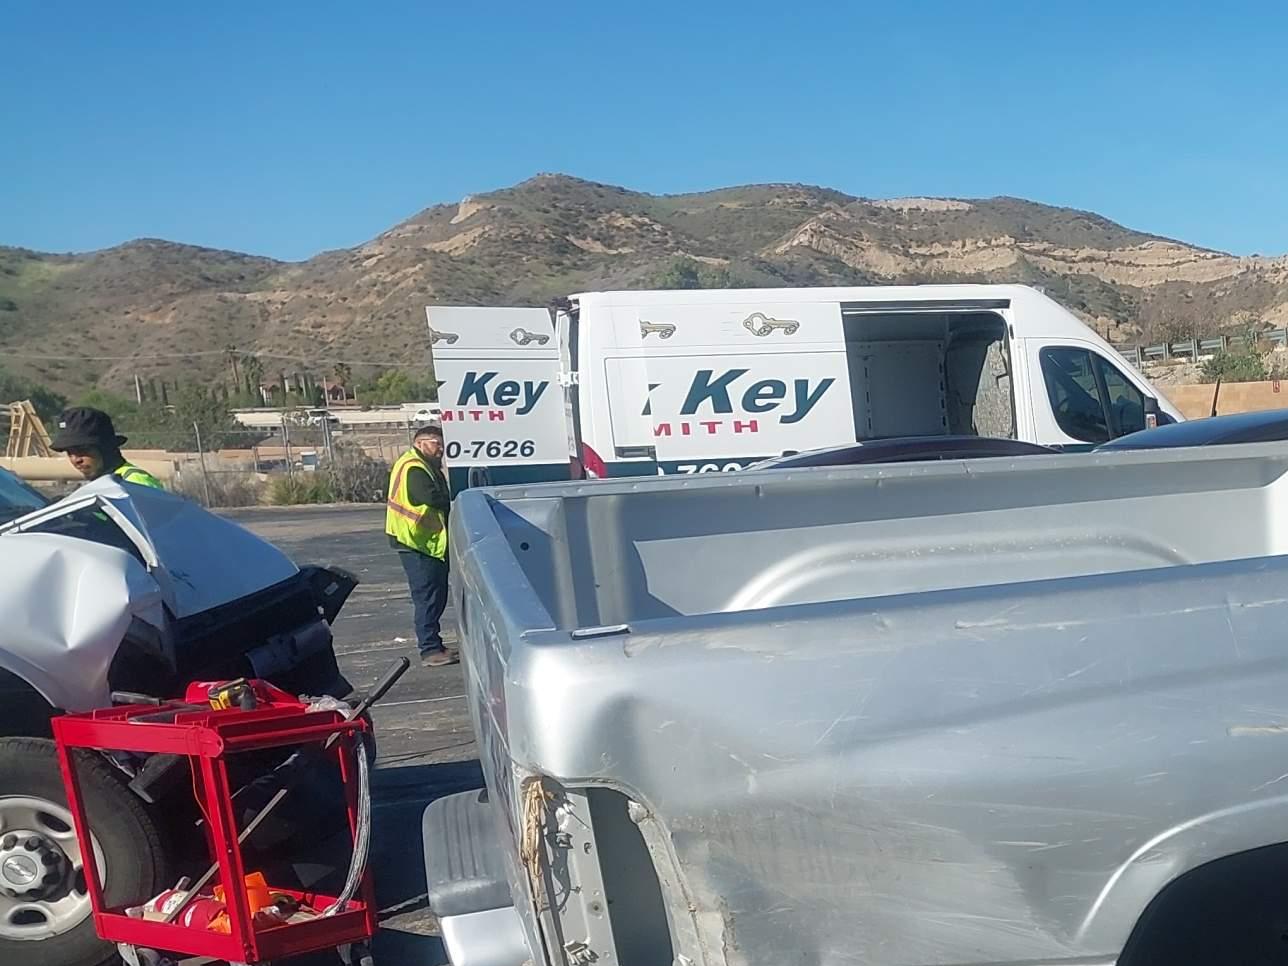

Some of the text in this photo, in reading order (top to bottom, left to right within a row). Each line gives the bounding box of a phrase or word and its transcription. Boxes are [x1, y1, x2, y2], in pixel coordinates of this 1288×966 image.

[456, 371, 550, 416] Key
[679, 368, 836, 424] Key
[445, 439, 536, 459] 0-7626
